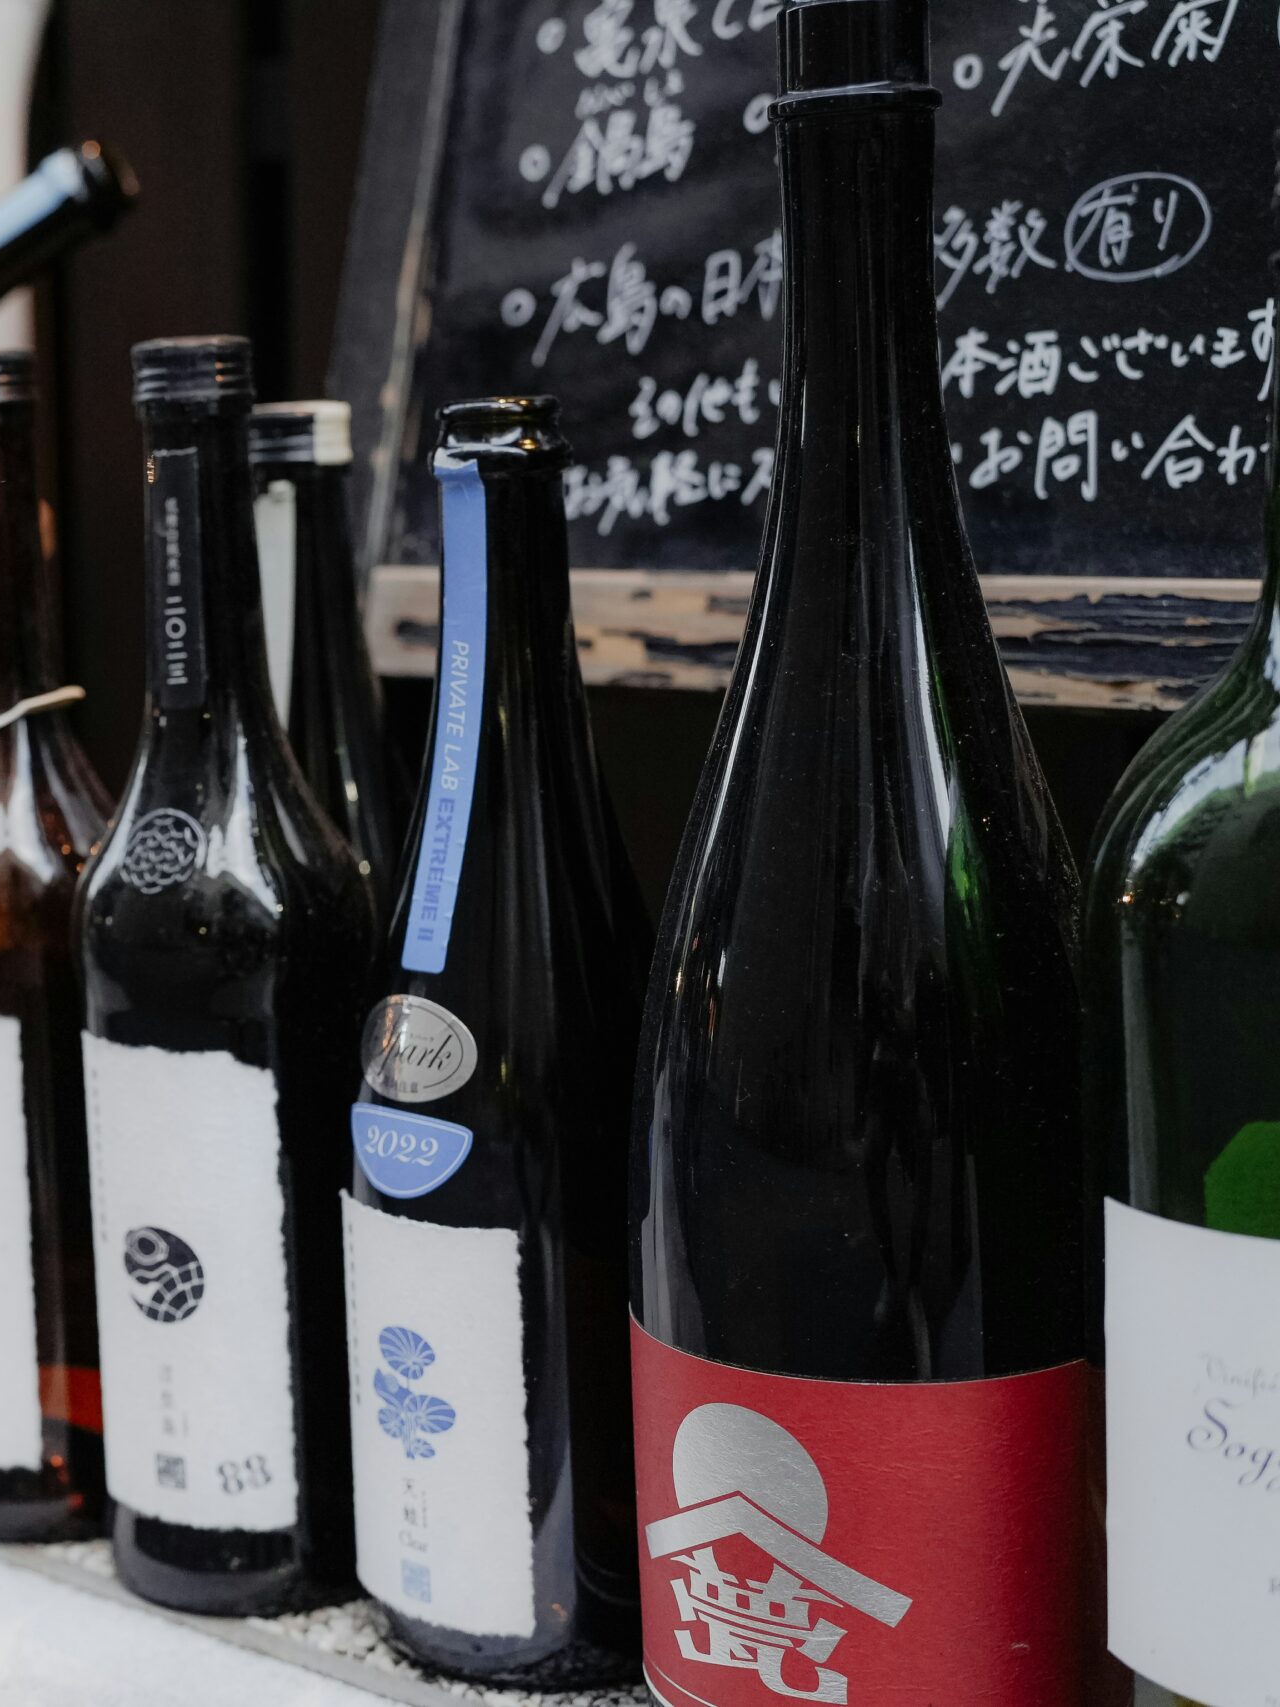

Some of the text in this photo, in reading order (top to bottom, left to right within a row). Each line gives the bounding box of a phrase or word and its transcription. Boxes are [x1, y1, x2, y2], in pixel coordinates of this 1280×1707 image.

[952, 409, 1270, 502] お問い合わ
[417, 640, 469, 942] PRIVATE LAB EXTREME II
[365, 1124, 440, 1168] 2022
